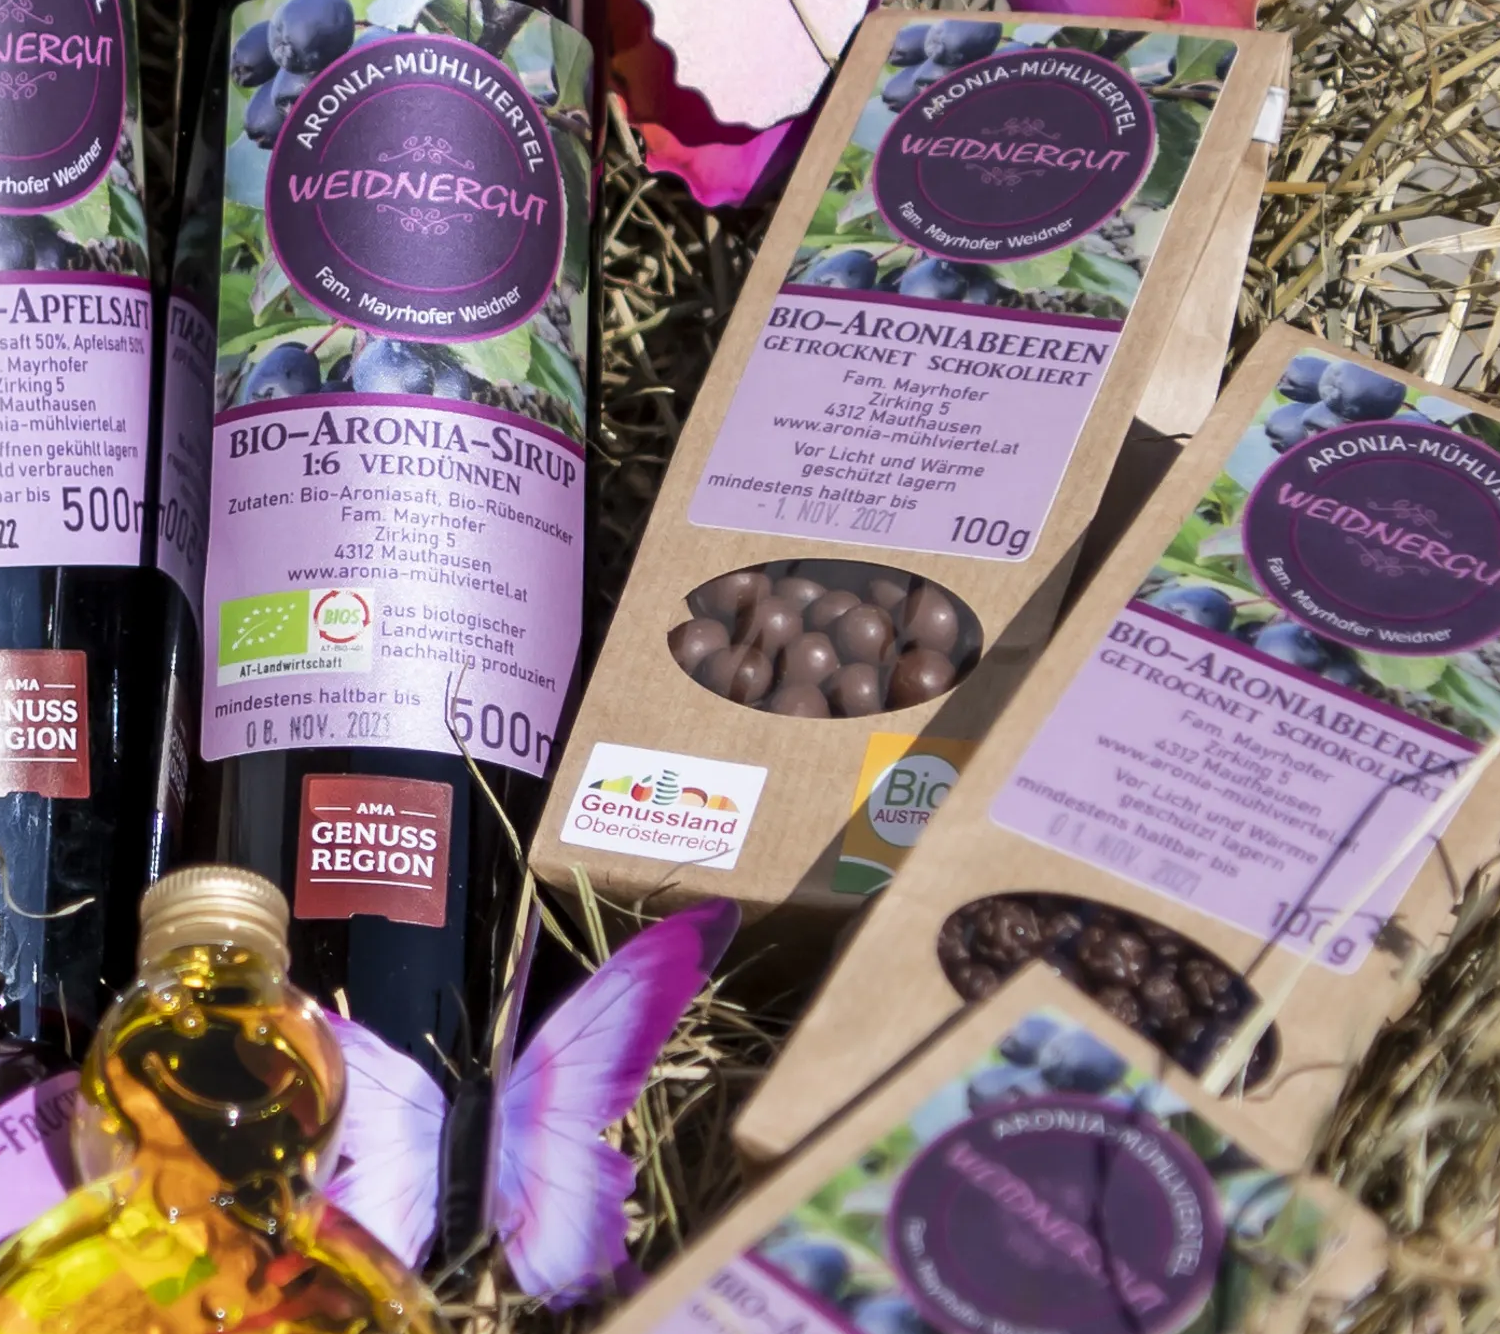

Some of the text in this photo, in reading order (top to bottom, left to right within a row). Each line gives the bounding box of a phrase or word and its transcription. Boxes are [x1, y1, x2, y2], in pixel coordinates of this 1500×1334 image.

[297, 49, 547, 172] ARONIA-MÜHLVIERTEL
[922, 58, 1137, 135] ARONIA-MÜHLVIERTEL
[52, 137, 104, 189] Weidner
[901, 134, 1130, 172] WEIDNERGUT
[289, 169, 548, 226] WEIDNERGUT
[926, 217, 1074, 251] Mayrhofer Weidner
[315, 266, 522, 325] Fam. Mayrhofer Weidner
[74, 336, 128, 353] Apfelsaft
[768, 307, 1111, 365] BIO-ARONIABEEREN
[8, 358, 88, 375] Mayrhofer
[764, 335, 1091, 387] GETROCKNET SCHOKOLIERT
[56, 378, 64, 392] 5
[843, 370, 989, 402] Fam. Mayrhofer
[0, 398, 96, 412] Mauthausen
[824, 403, 982, 435] 4312 Mauthausen
[869, 392, 950, 416] Zirking 5
[47, 441, 101, 461] gekühlt
[103, 443, 138, 460] lagern
[229, 411, 576, 488] BIO-ARONIA-SIRUP
[773, 416, 1019, 455] www.aronia-mühlviertel.at
[19, 463, 113, 478] verbrauchen
[303, 451, 521, 495] 1:6 VERDÜNNEN
[794, 442, 984, 477] Vor Licht und Wärme
[708, 473, 918, 510] mindestens haltbar bis
[801, 462, 956, 493] geschützt lagern
[27, 487, 50, 503] bis
[228, 486, 573, 545] Zutaten: Bio-Aroniasaft, Bio-Rübenzucker
[341, 508, 486, 534] Fam. Mayrhofer
[797, 501, 840, 527] NOV.
[851, 506, 896, 533] 2021
[375, 527, 456, 548] Zirking 5
[950, 515, 1031, 555] 100g
[334, 545, 492, 574] 4312 Mauthausen
[288, 567, 528, 603] www.aronia-mühlviertel.at
[323, 609, 360, 625] BIOS
[383, 605, 526, 639] aus biologischer
[1293, 588, 1373, 640] Mayrhofer
[381, 625, 514, 656] Landwirtschaft
[240, 657, 342, 677] AT-Landwirtschaft
[380, 644, 556, 692] nachhaltig produziert
[5, 679, 39, 691] AMA
[1100, 648, 1263, 725] GETROCKNET
[215, 689, 420, 717] mindestens haltbar bis
[290, 714, 334, 742] NOV.
[1205, 739, 1272, 783] Zirking
[1234, 733, 1334, 785] Mayrhofer
[1016, 776, 1128, 831] mindestens
[1203, 758, 1322, 817] Mauthausen
[357, 803, 395, 816] AMA
[581, 793, 738, 835] Genussland
[873, 809, 930, 825] AUSTR
[312, 822, 437, 851] GENUSS
[575, 814, 730, 853] Oberösterreich
[311, 849, 434, 878] REGION
